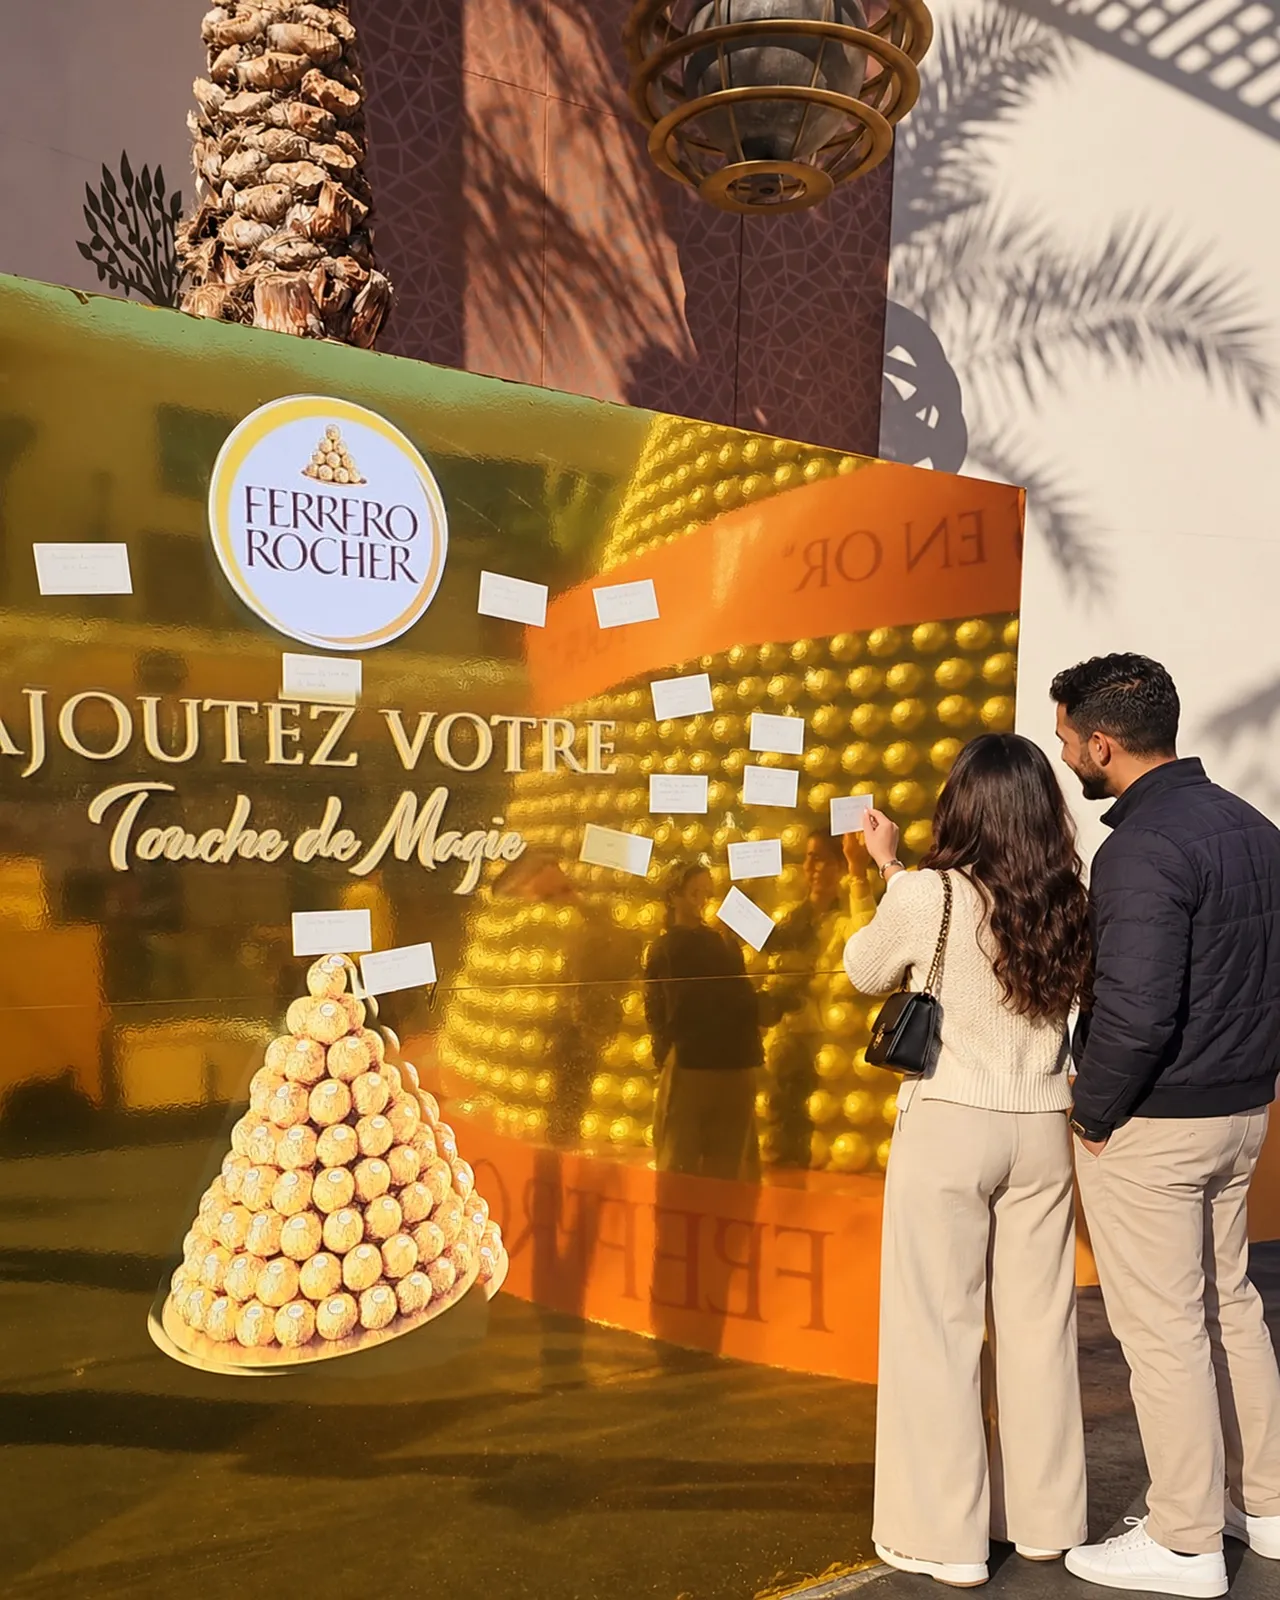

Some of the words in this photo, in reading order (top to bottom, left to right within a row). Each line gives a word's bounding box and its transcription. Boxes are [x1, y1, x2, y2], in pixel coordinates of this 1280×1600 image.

[245, 485, 418, 542] FERRERO
[246, 528, 419, 584] ROCHER
[378, 709, 617, 775] VOTRE
[87, 781, 289, 871] Touche
[292, 795, 362, 863] de
[348, 786, 527, 895] Magie
